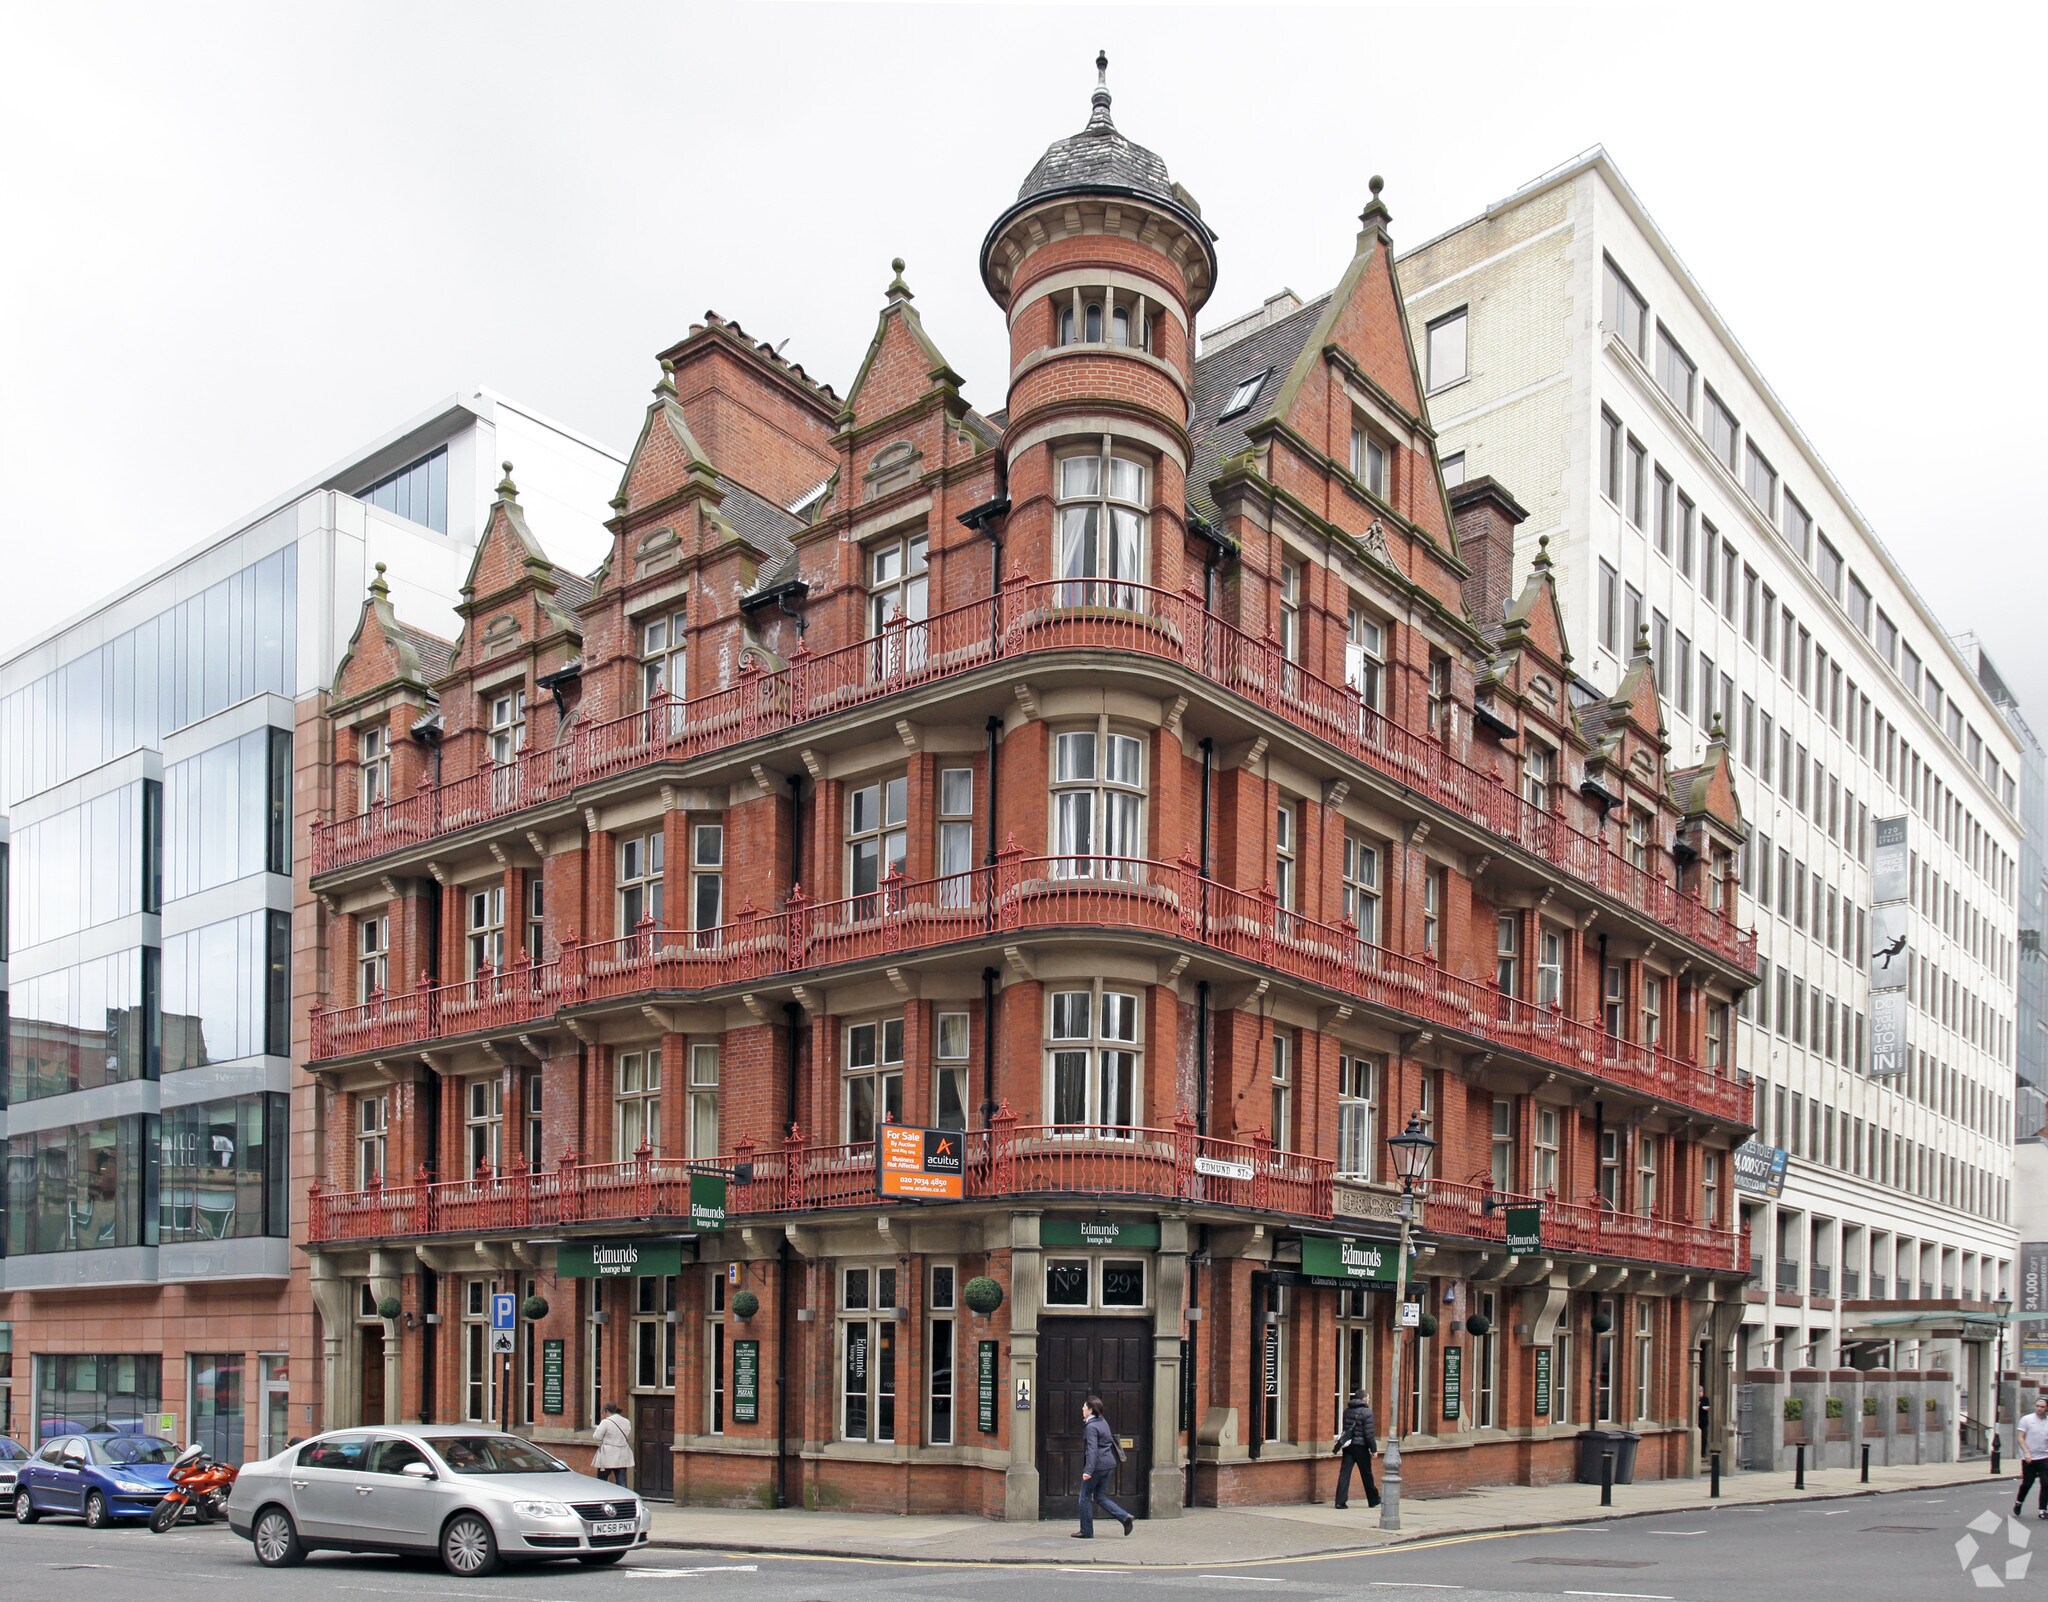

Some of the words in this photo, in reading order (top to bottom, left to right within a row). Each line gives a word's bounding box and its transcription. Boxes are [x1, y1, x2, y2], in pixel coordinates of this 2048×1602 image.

[1878, 836, 1903, 844] STREET
[1876, 857, 1904, 867] OFFICE
[1876, 864, 1904, 874] SPACE
[1874, 999, 1895, 1010] DO
[1875, 1014, 1895, 1024] YOU
[1874, 1023, 1896, 1032] CAN
[1874, 1032, 1895, 1043] TO
[1874, 1043, 1896, 1053] GET
[1873, 1052, 1895, 1070] IN
[887, 1130, 899, 1139] For
[902, 1131, 920, 1141] Sale
[1757, 1144, 1765, 1156] TO
[1764, 1148, 1774, 1159] LET
[898, 1162, 920, 1170] Affected
[927, 1155, 959, 1166] acuitus
[1201, 1162, 1231, 1175] EDMUND
[930, 1178, 947, 1186] 4850
[900, 1185, 946, 1193] www.acuitus.co.uk
[692, 1204, 725, 1219] Edmunds
[697, 1219, 711, 1228] lounge
[1081, 1223, 1119, 1235] Edmunds
[1087, 1236, 1103, 1245] lounge
[1104, 1236, 1113, 1244] bar
[1507, 1233, 1539, 1246] Edmunds
[593, 1244, 638, 1264] Edmunds
[1341, 1243, 1381, 1268] Edmunds
[1512, 1246, 1526, 1254] lounge
[600, 1265, 621, 1275] lounge
[621, 1264, 631, 1273] bar
[1347, 1266, 1366, 1277] lounge
[1366, 1268, 1376, 1277] bar
[1311, 1276, 1337, 1286] Edmunds
[498, 1298, 512, 1326] P
[1403, 1306, 1409, 1316] P
[856, 1338, 866, 1378] Edmunds
[1266, 1329, 1278, 1392] Edmunds
[597, 1524, 617, 1533] NC58
[618, 1522, 632, 1531] PNX
